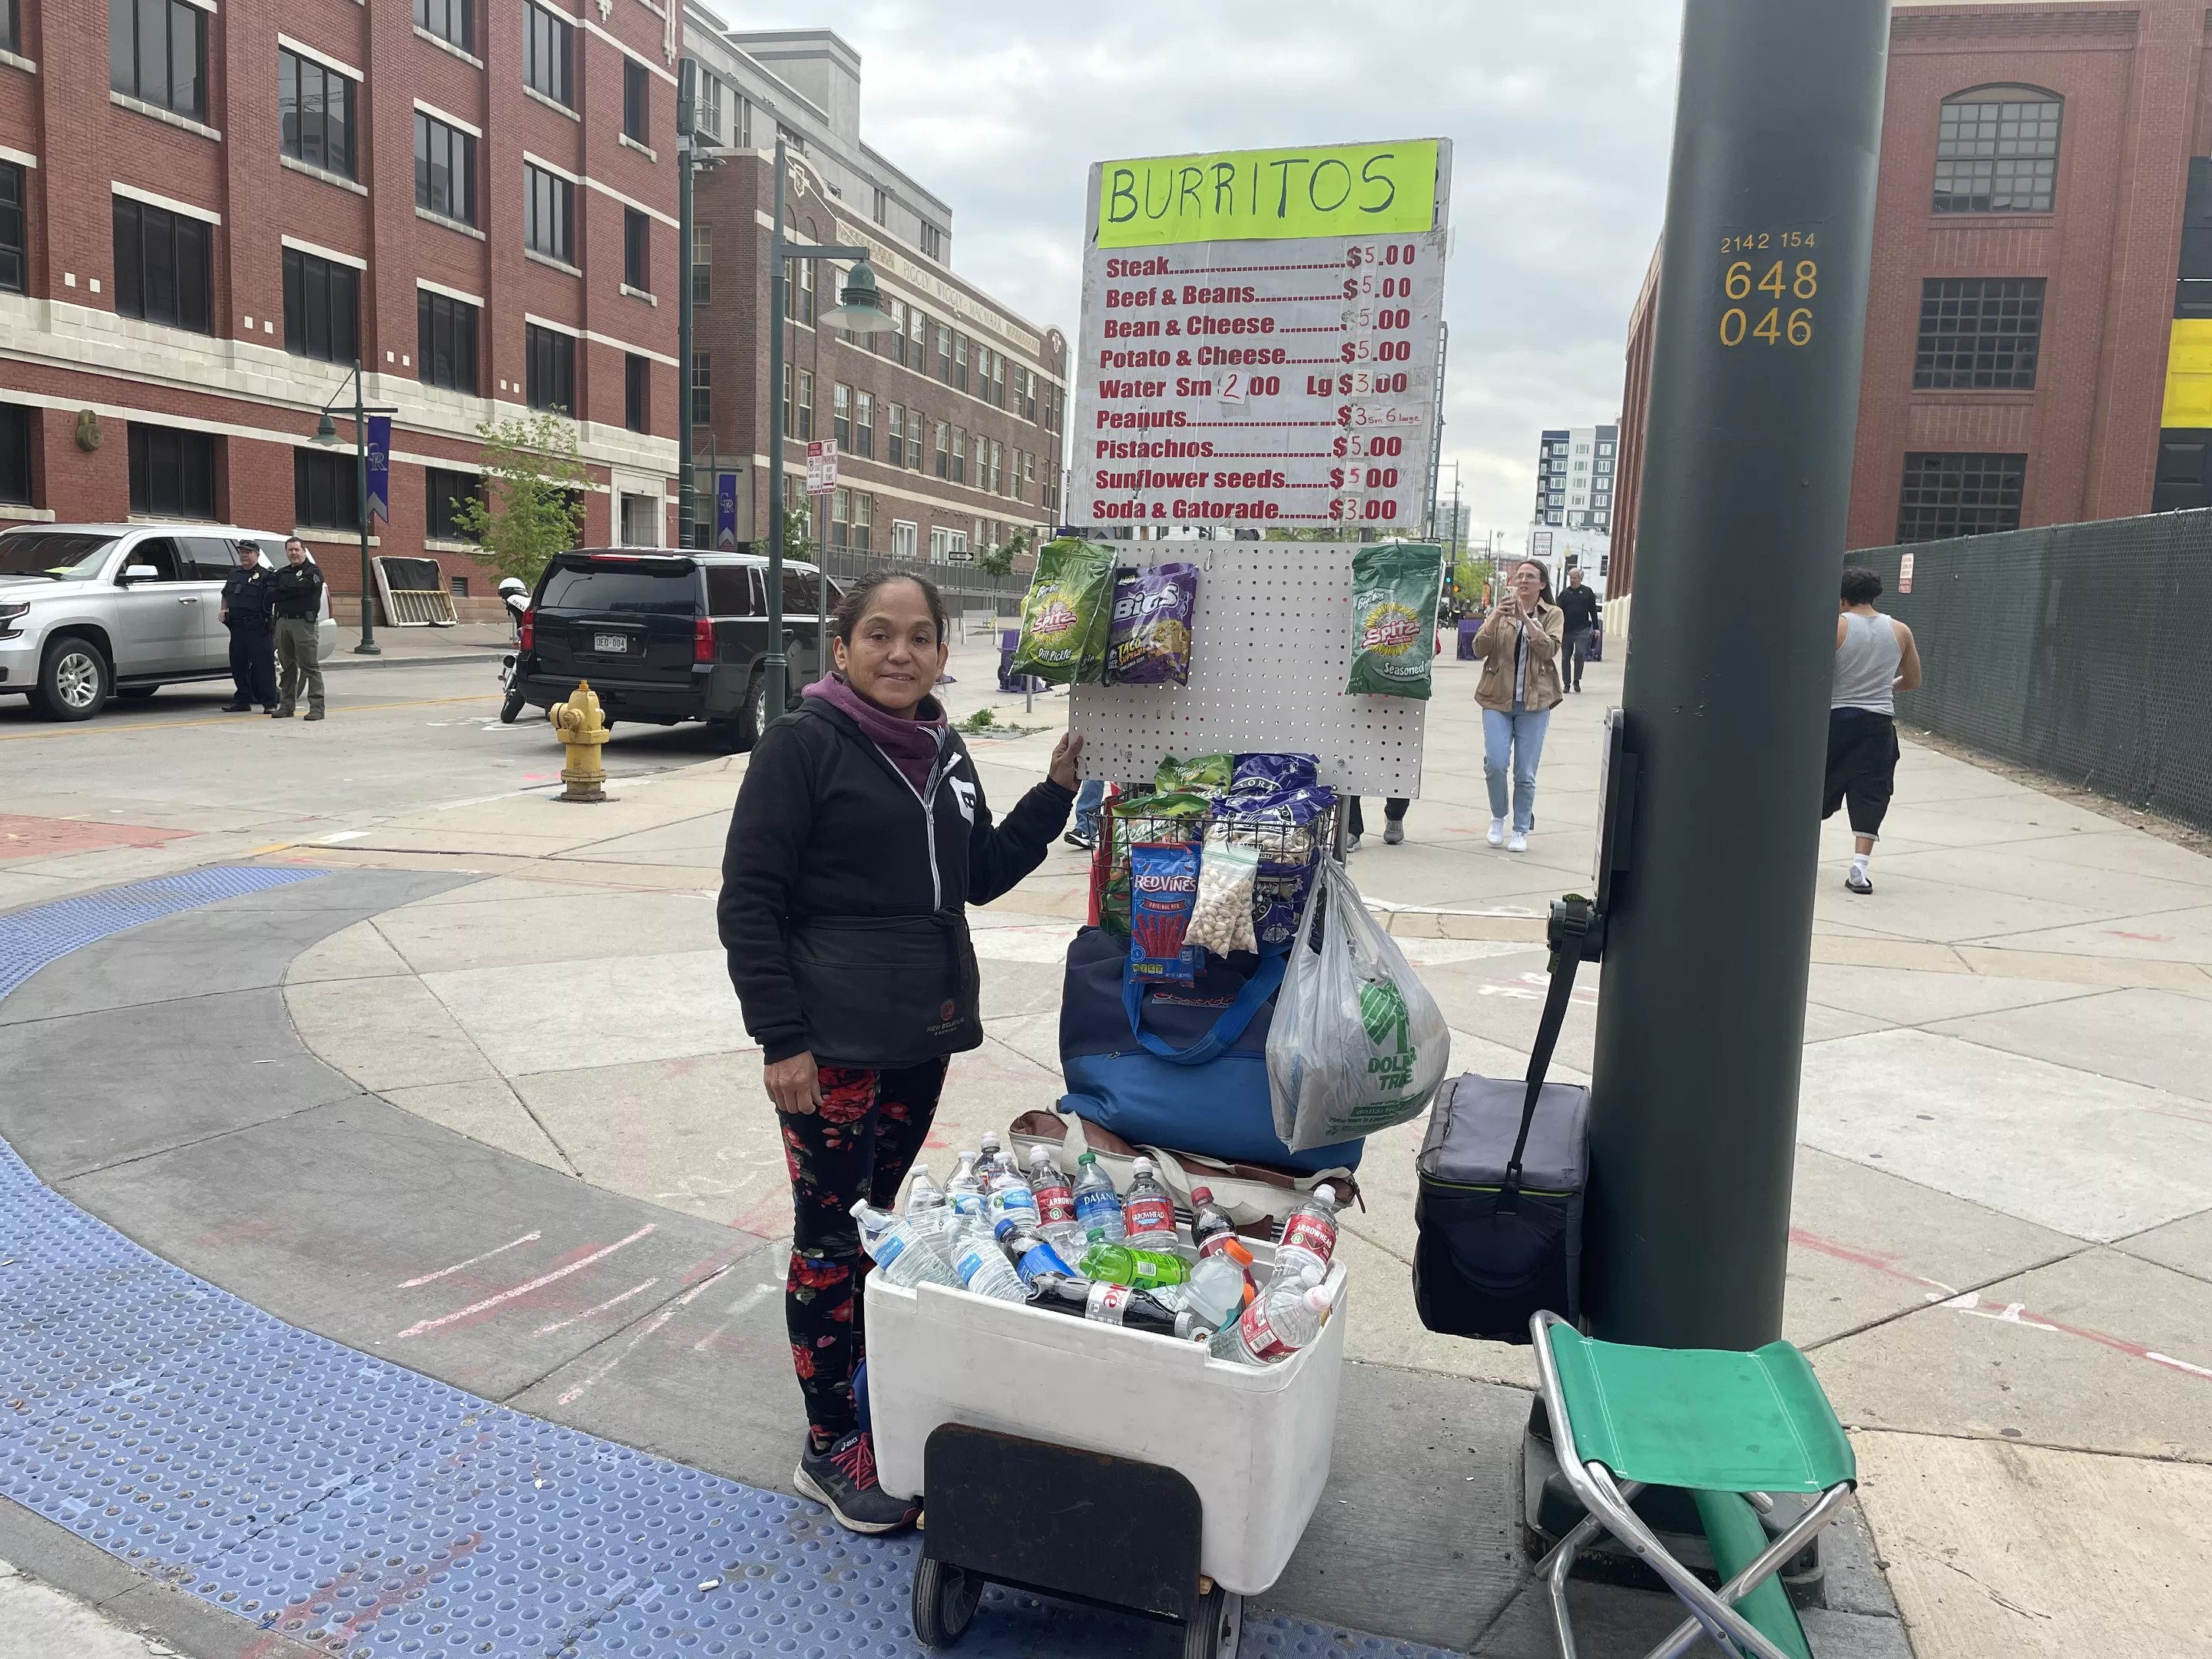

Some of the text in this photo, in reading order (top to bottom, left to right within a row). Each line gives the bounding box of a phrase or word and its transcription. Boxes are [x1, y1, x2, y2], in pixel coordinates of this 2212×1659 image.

[1108, 154, 1395, 223] BURRITOS
[1720, 232, 1815, 253] 2142 154
[1107, 244, 1415, 277] Steak $5.00
[1725, 260, 1817, 300] 648
[1106, 276, 1411, 308] Beef & Beans $5.00
[1104, 320, 1160, 338] Bean
[1165, 320, 1181, 336] &
[1187, 316, 1274, 335] Cheese
[1720, 307, 1813, 346] 046
[1100, 340, 1410, 369] Potato & Cheese $5.00
[1099, 380, 1166, 399] Water
[1177, 377, 1211, 396] Sm
[1307, 376, 1333, 397] Lg
[1339, 373, 1407, 396] $3.00
[1097, 410, 1187, 429] Peanuts
[1386, 408, 1396, 422] 6
[1399, 413, 1421, 424] large
[826, 443, 833, 453] NO
[1333, 435, 1402, 459] $5.00
[1096, 469, 1209, 489] Sunflower
[1214, 469, 1286, 488] seeds
[1093, 498, 1396, 521] Soda & Gatorade $3.00
[512, 600, 525, 611] DENV
[1357, 594, 1372, 611] Big
[1038, 647, 1048, 659] Dill
[1050, 648, 1072, 661] Pickle
[1118, 638, 1141, 657] TACO
[1383, 661, 1425, 677] Seasoned
[1132, 1211, 1165, 1223] ARROWHEAD
